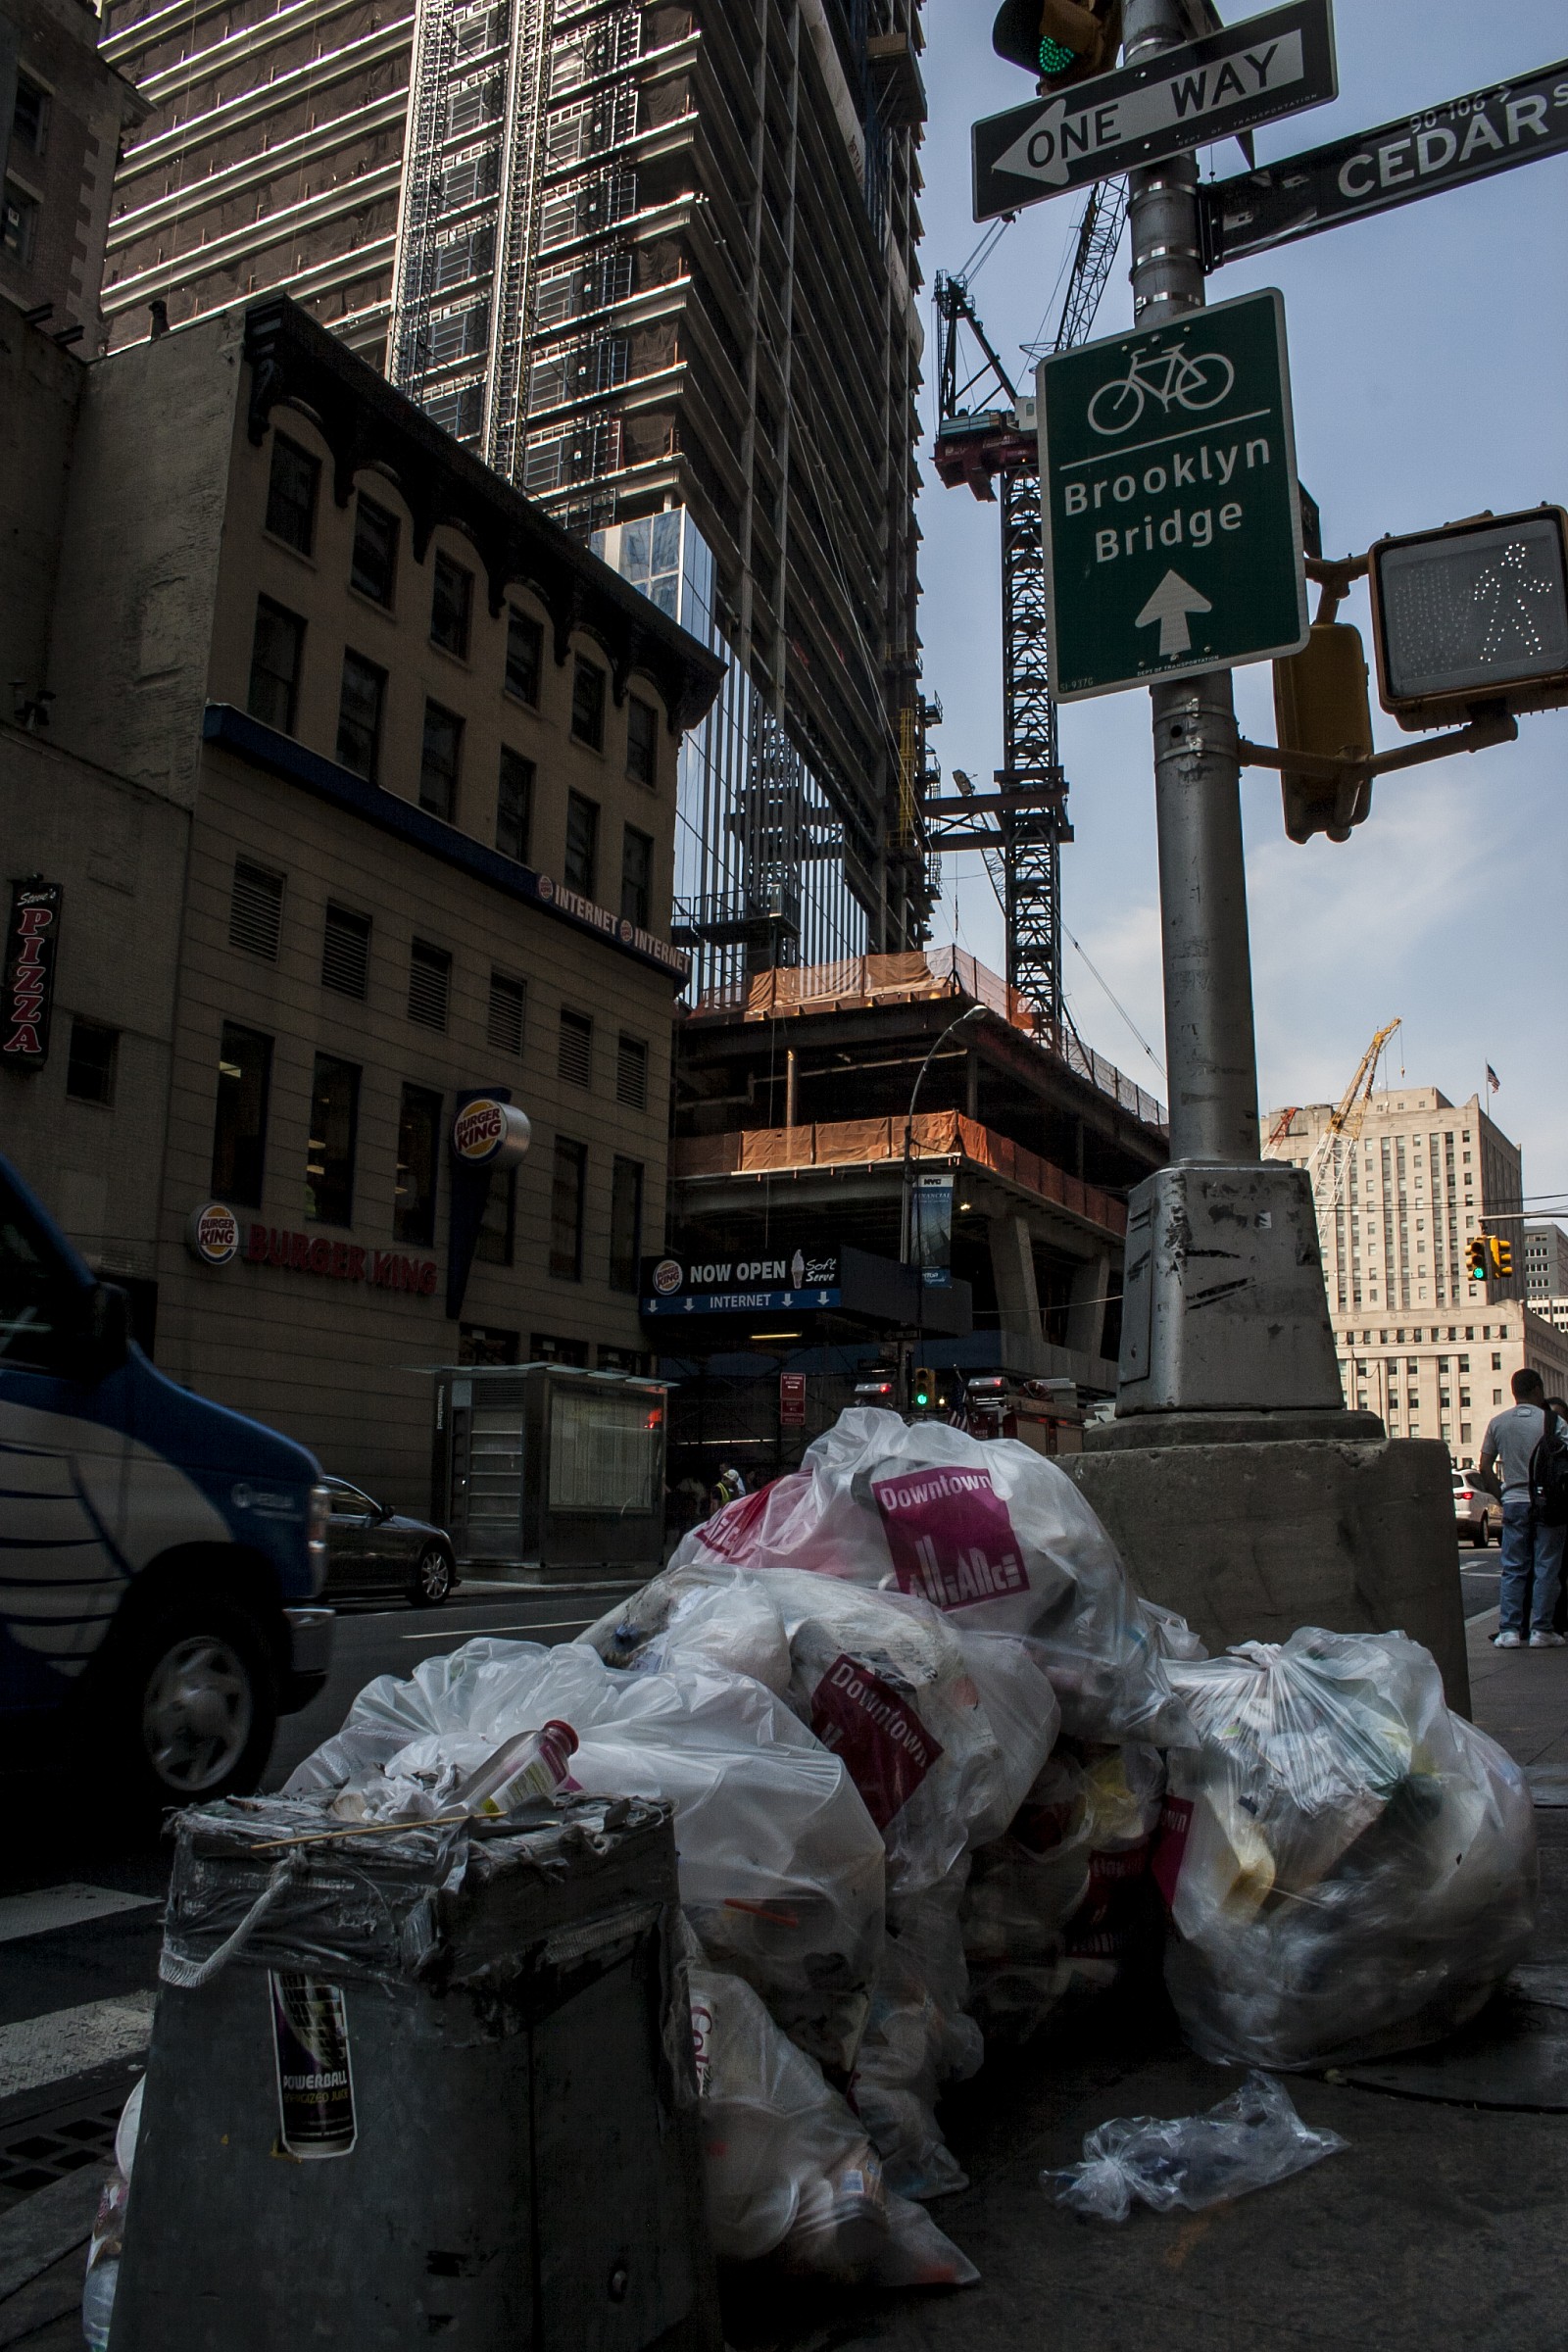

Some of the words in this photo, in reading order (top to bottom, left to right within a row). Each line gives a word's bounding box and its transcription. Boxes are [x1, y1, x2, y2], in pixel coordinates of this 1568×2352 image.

[1028, 104, 1121, 169] ONE
[1171, 44, 1278, 118] WAY
[1178, 134, 1200, 146] DEPT
[1211, 126, 1222, 135] OF
[1233, 93, 1318, 126] TRANSPORTATION
[1408, 92, 1486, 134] 90-106
[1338, 94, 1549, 198] CEDAR
[1064, 437, 1270, 516] Brooklyn
[1095, 502, 1243, 564] Bridge
[1137, 668, 1152, 677] DEPT
[1163, 655, 1219, 671] TRANSPORTATION
[555, 884, 619, 935] INTERNET
[633, 927, 692, 975] INTERNET
[3, 907, 53, 1054] PIZZA
[457, 1107, 500, 1135] BURGER
[458, 1119, 502, 1152] KING
[200, 1229, 235, 1245] KING
[201, 1218, 235, 1231] BURGER
[247, 1224, 367, 1282] BURGER
[372, 1250, 438, 1295] KING
[657, 1265, 678, 1278] BURGER
[689, 1263, 732, 1284] NOW
[736, 1260, 787, 1282] OPEN
[805, 1257, 837, 1272] Soft
[657, 1272, 679, 1287] KING
[806, 1271, 835, 1283] Serve
[710, 1294, 772, 1309] INTERNET
[879, 1474, 993, 1511] Downtown
[830, 1662, 929, 1768] Downtown
[282, 2070, 348, 2090] POWERBALL
